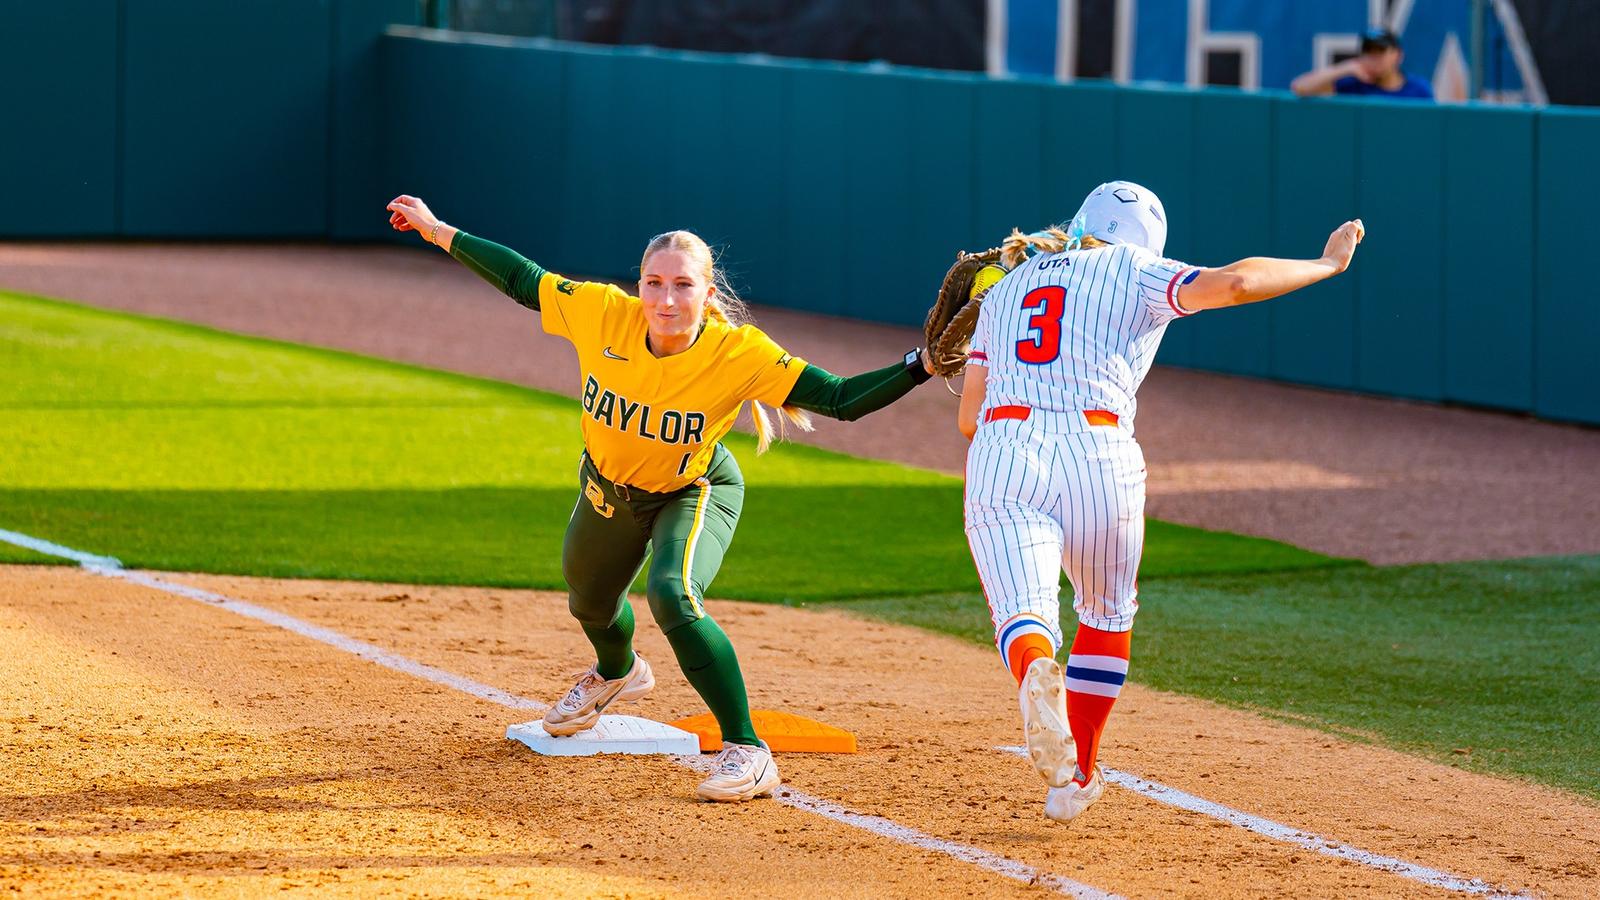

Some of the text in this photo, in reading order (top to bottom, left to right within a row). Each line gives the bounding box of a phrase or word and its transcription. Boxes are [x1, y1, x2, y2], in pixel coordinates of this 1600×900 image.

[1107, 220, 1119, 234] 3
[1038, 257, 1071, 271] UTA
[1015, 285, 1068, 366] 3
[582, 373, 706, 446] BAYLOR
